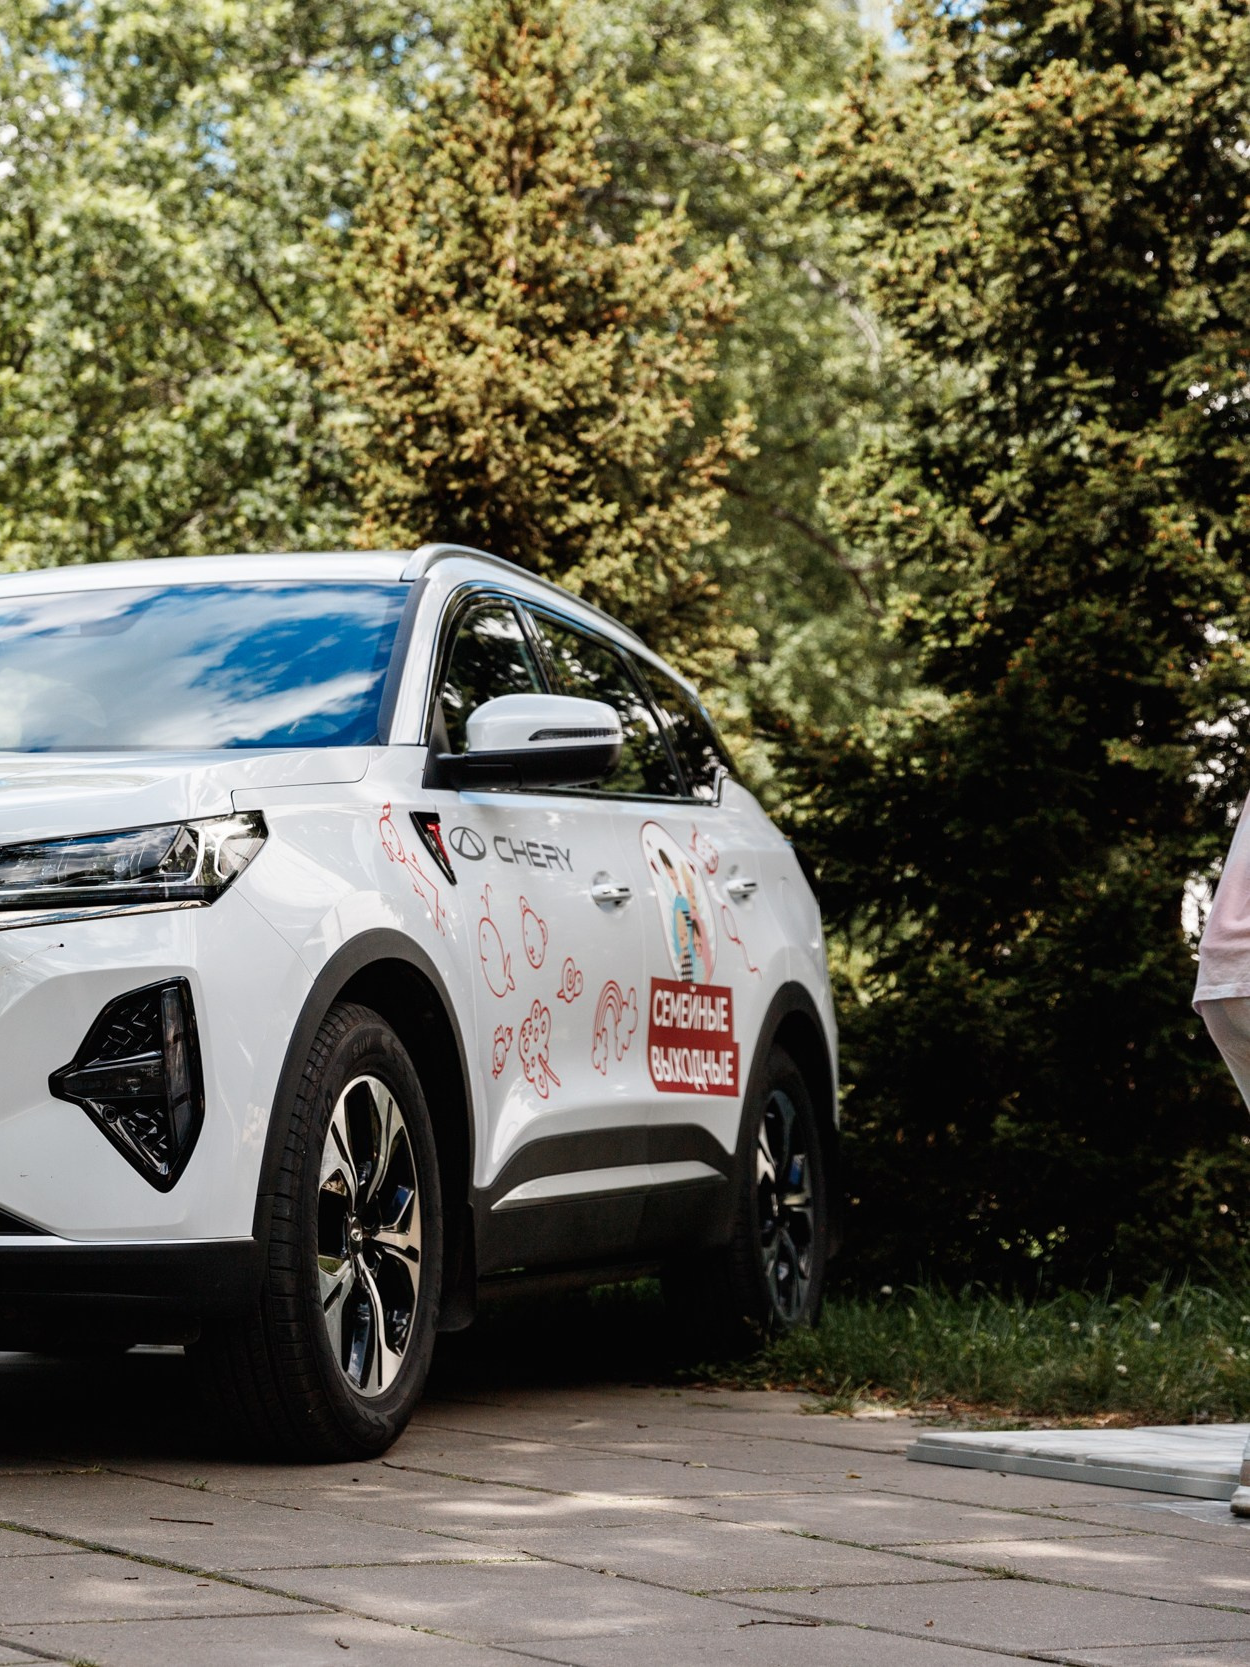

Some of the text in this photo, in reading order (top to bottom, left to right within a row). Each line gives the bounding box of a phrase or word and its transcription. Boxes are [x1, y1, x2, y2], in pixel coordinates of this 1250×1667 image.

[493, 834, 576, 873] CHERY
[652, 984, 730, 1032] СЕМЕЙНЫЕ
[650, 1044, 735, 1092] ВЫХОДНЫЕ
